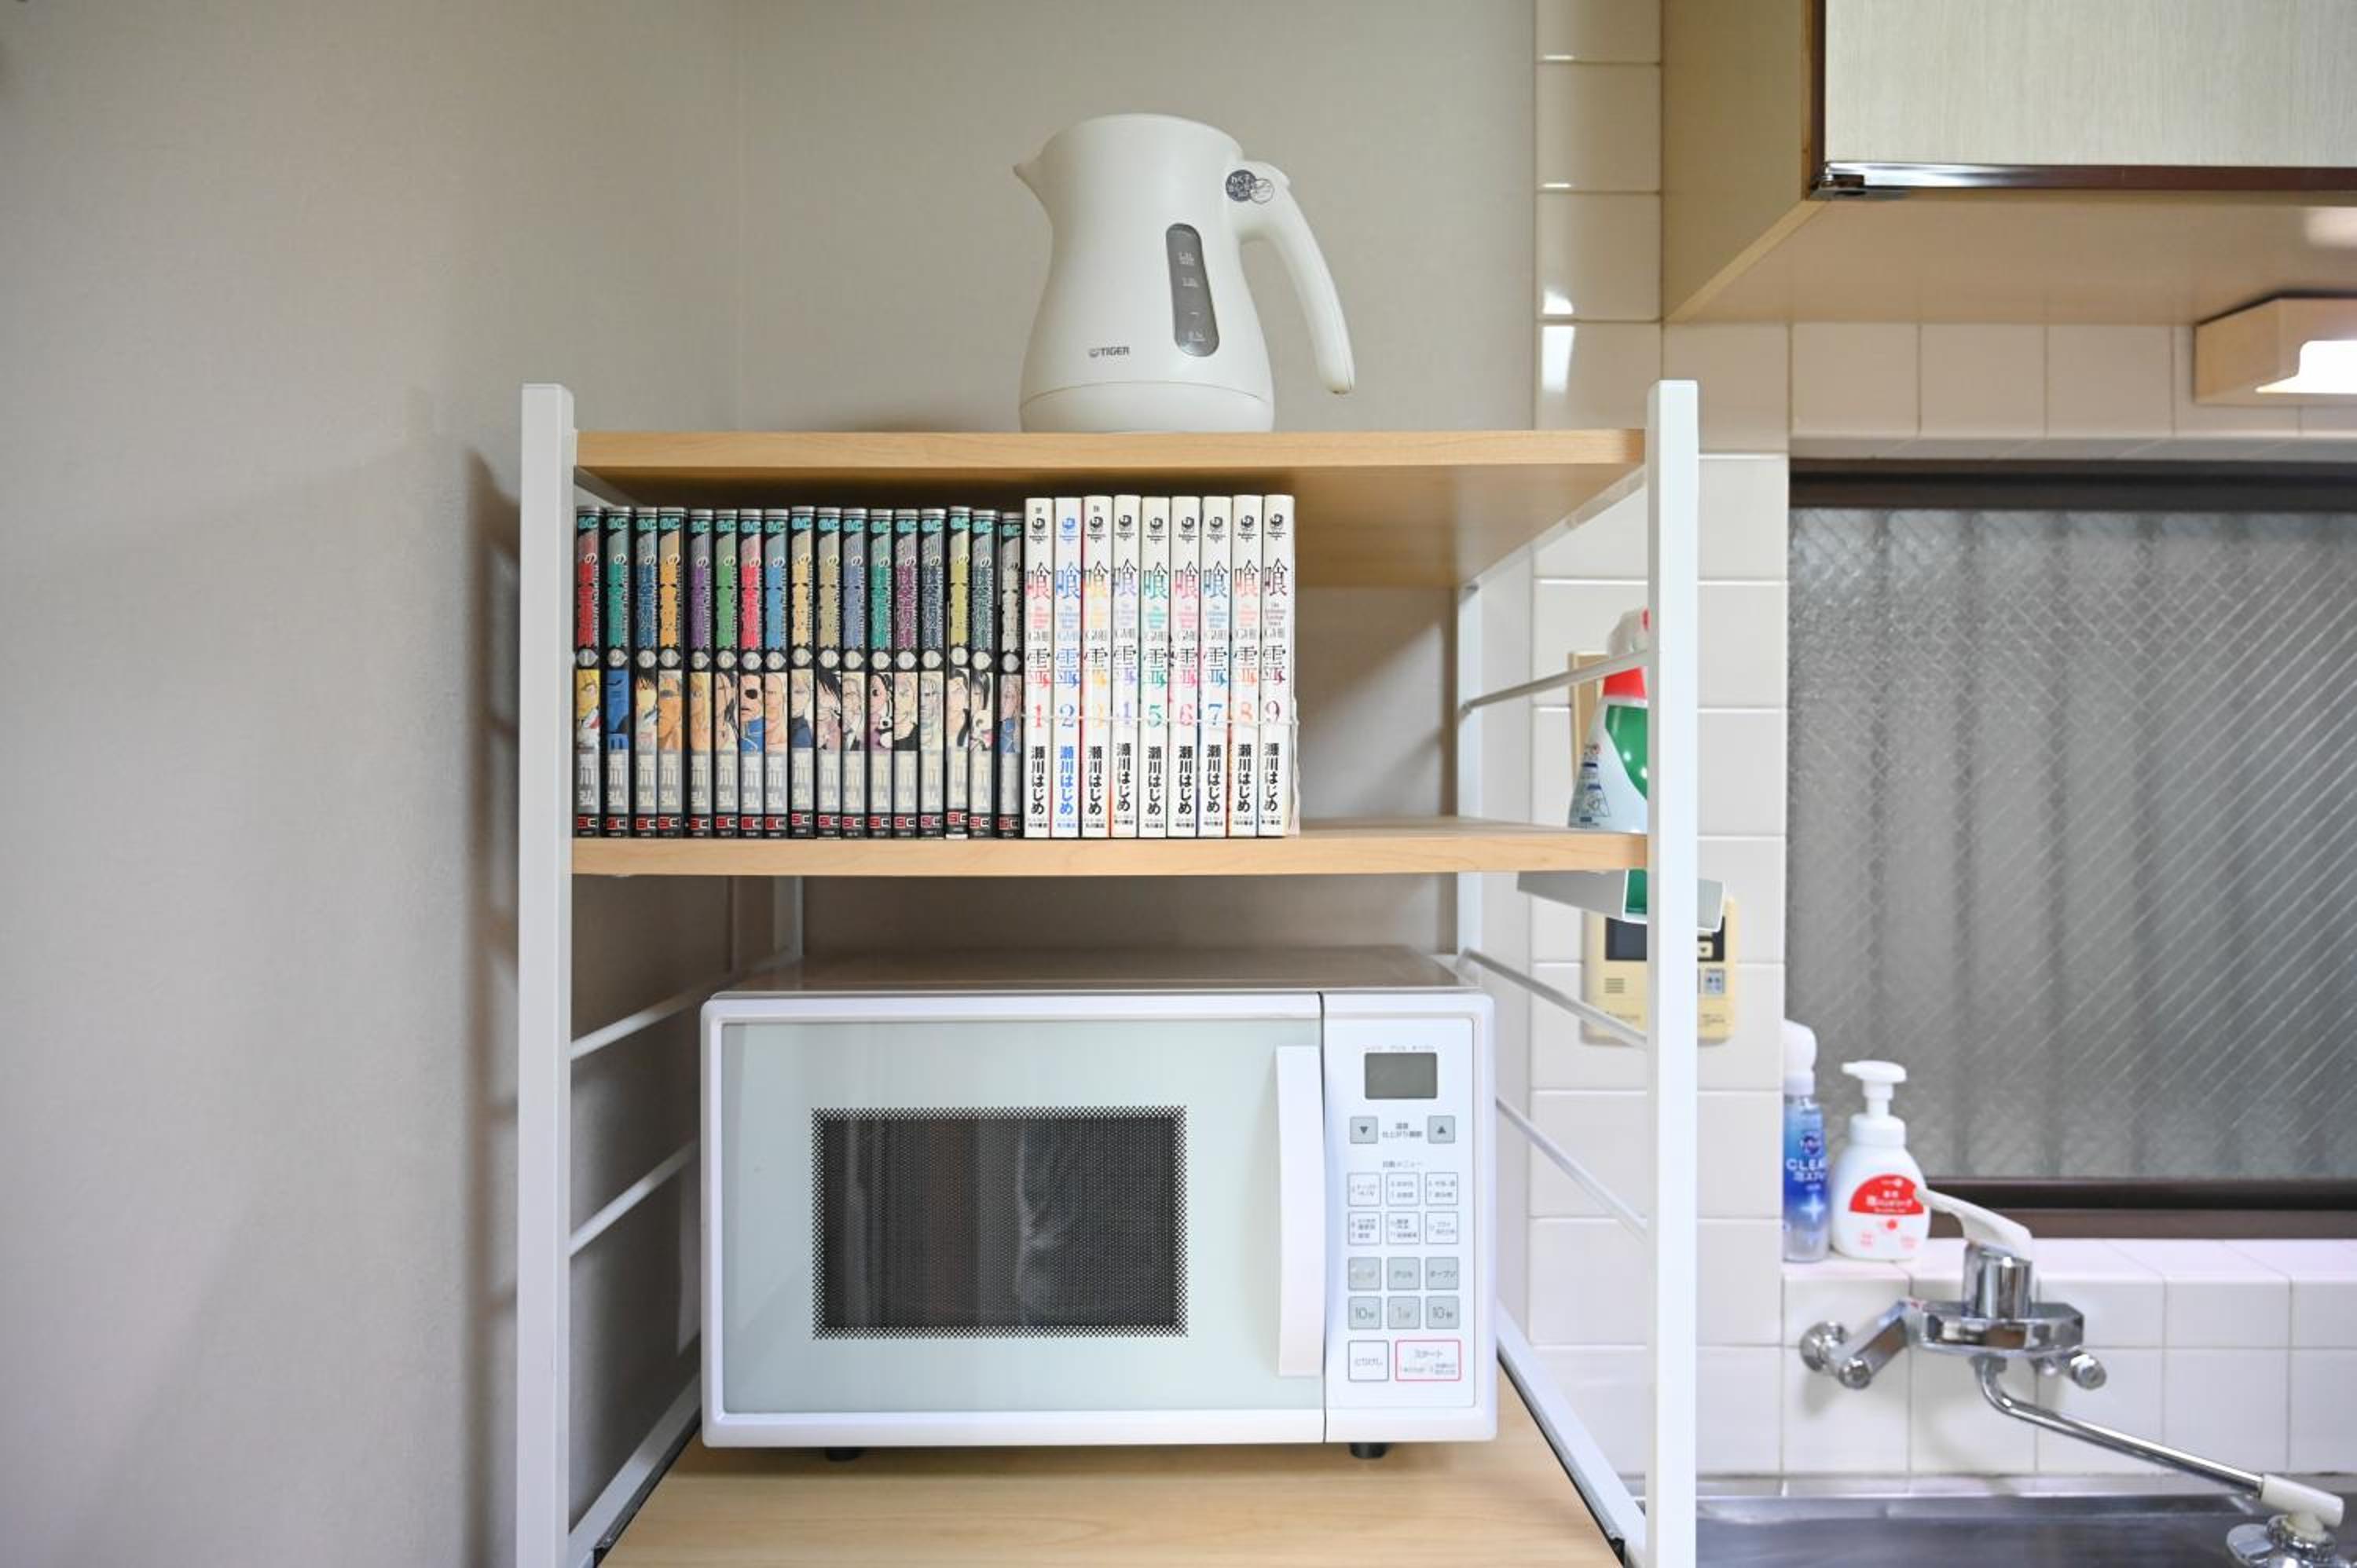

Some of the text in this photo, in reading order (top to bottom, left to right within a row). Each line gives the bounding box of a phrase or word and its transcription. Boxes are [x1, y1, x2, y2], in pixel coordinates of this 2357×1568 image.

[1098, 346, 1130, 357] TIGER
[1035, 704, 1042, 727] 1
[1060, 704, 1075, 727] 2
[1148, 705, 1163, 727] 5
[1180, 704, 1193, 726] 6
[1208, 704, 1222, 725] 7
[1241, 702, 1253, 723] 8
[1265, 700, 1280, 723] 9
[1031, 746, 1045, 815] 瀬川はじめ
[1060, 746, 1074, 815] 瀬川はじめ
[1089, 746, 1102, 815] 瀬川はじめ
[1116, 743, 1131, 811] 瀬川はじめ
[1148, 746, 1161, 815] 瀬川はじめ
[1178, 746, 1193, 814] 瀬川はじめ
[1207, 745, 1221, 812] 瀬川はじめ
[1237, 744, 1251, 812] 瀬川はじめ
[1264, 743, 1279, 811] 瀬川はじめ
